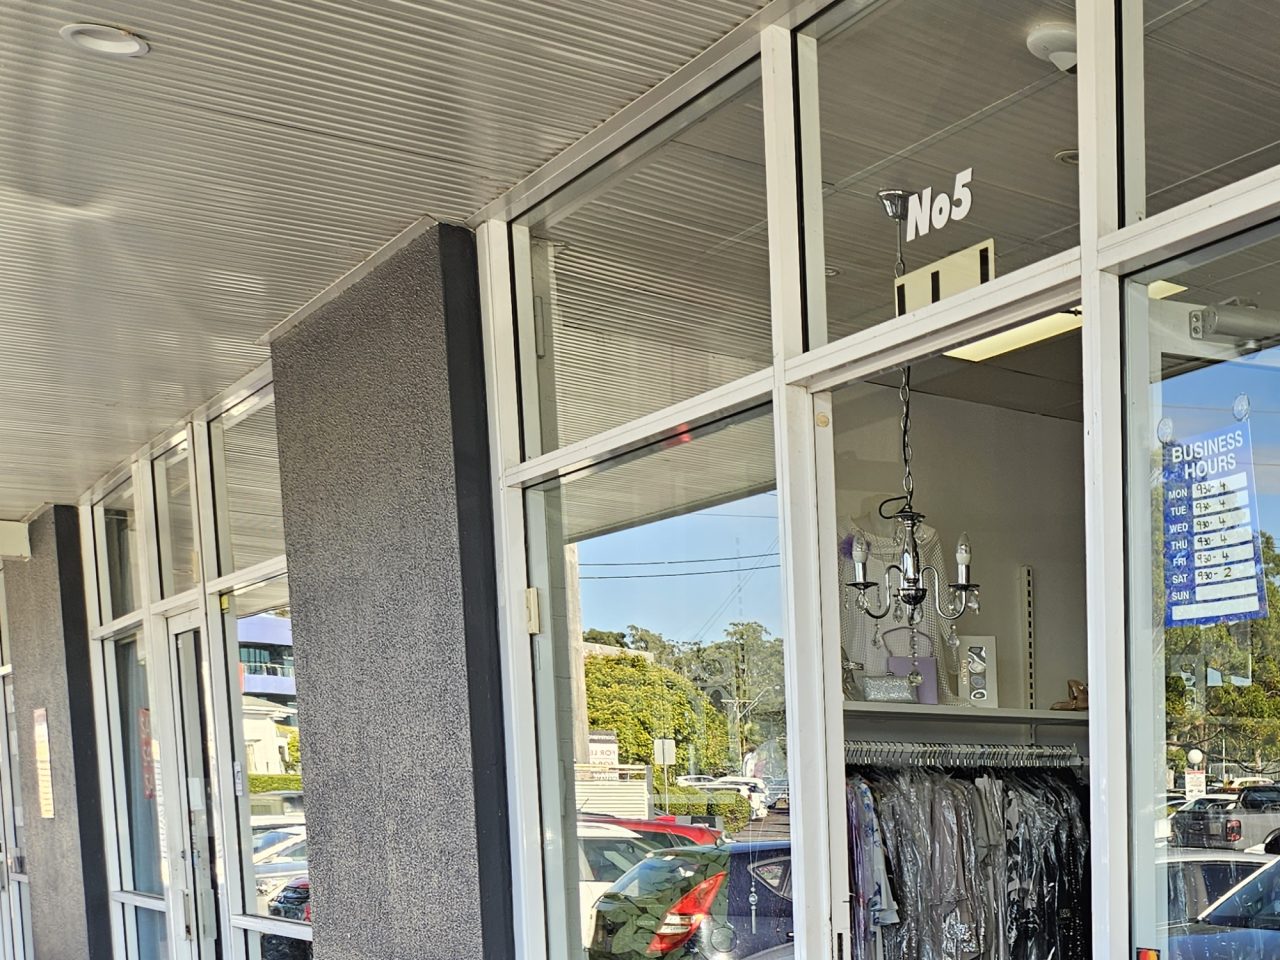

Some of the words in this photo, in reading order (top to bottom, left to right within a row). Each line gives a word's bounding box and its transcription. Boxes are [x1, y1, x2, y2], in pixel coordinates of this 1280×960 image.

[906, 167, 973, 243] No5
[1172, 430, 1243, 463] BUSINESS
[1184, 453, 1236, 480] HOURS
[1168, 488, 1188, 499] MON
[1219, 480, 1226, 490] 4
[1170, 505, 1187, 516] TUE
[1218, 499, 1226, 508] 4
[1169, 523, 1188, 533] WED
[1219, 516, 1226, 526] 4
[1171, 539, 1188, 550] THU
[1220, 534, 1227, 543] 4
[1172, 557, 1187, 567] FRI
[1222, 551, 1229, 560] 4
[1172, 574, 1188, 584] SAT
[1223, 566, 1232, 578] 2
[1171, 591, 1190, 601] SUN
